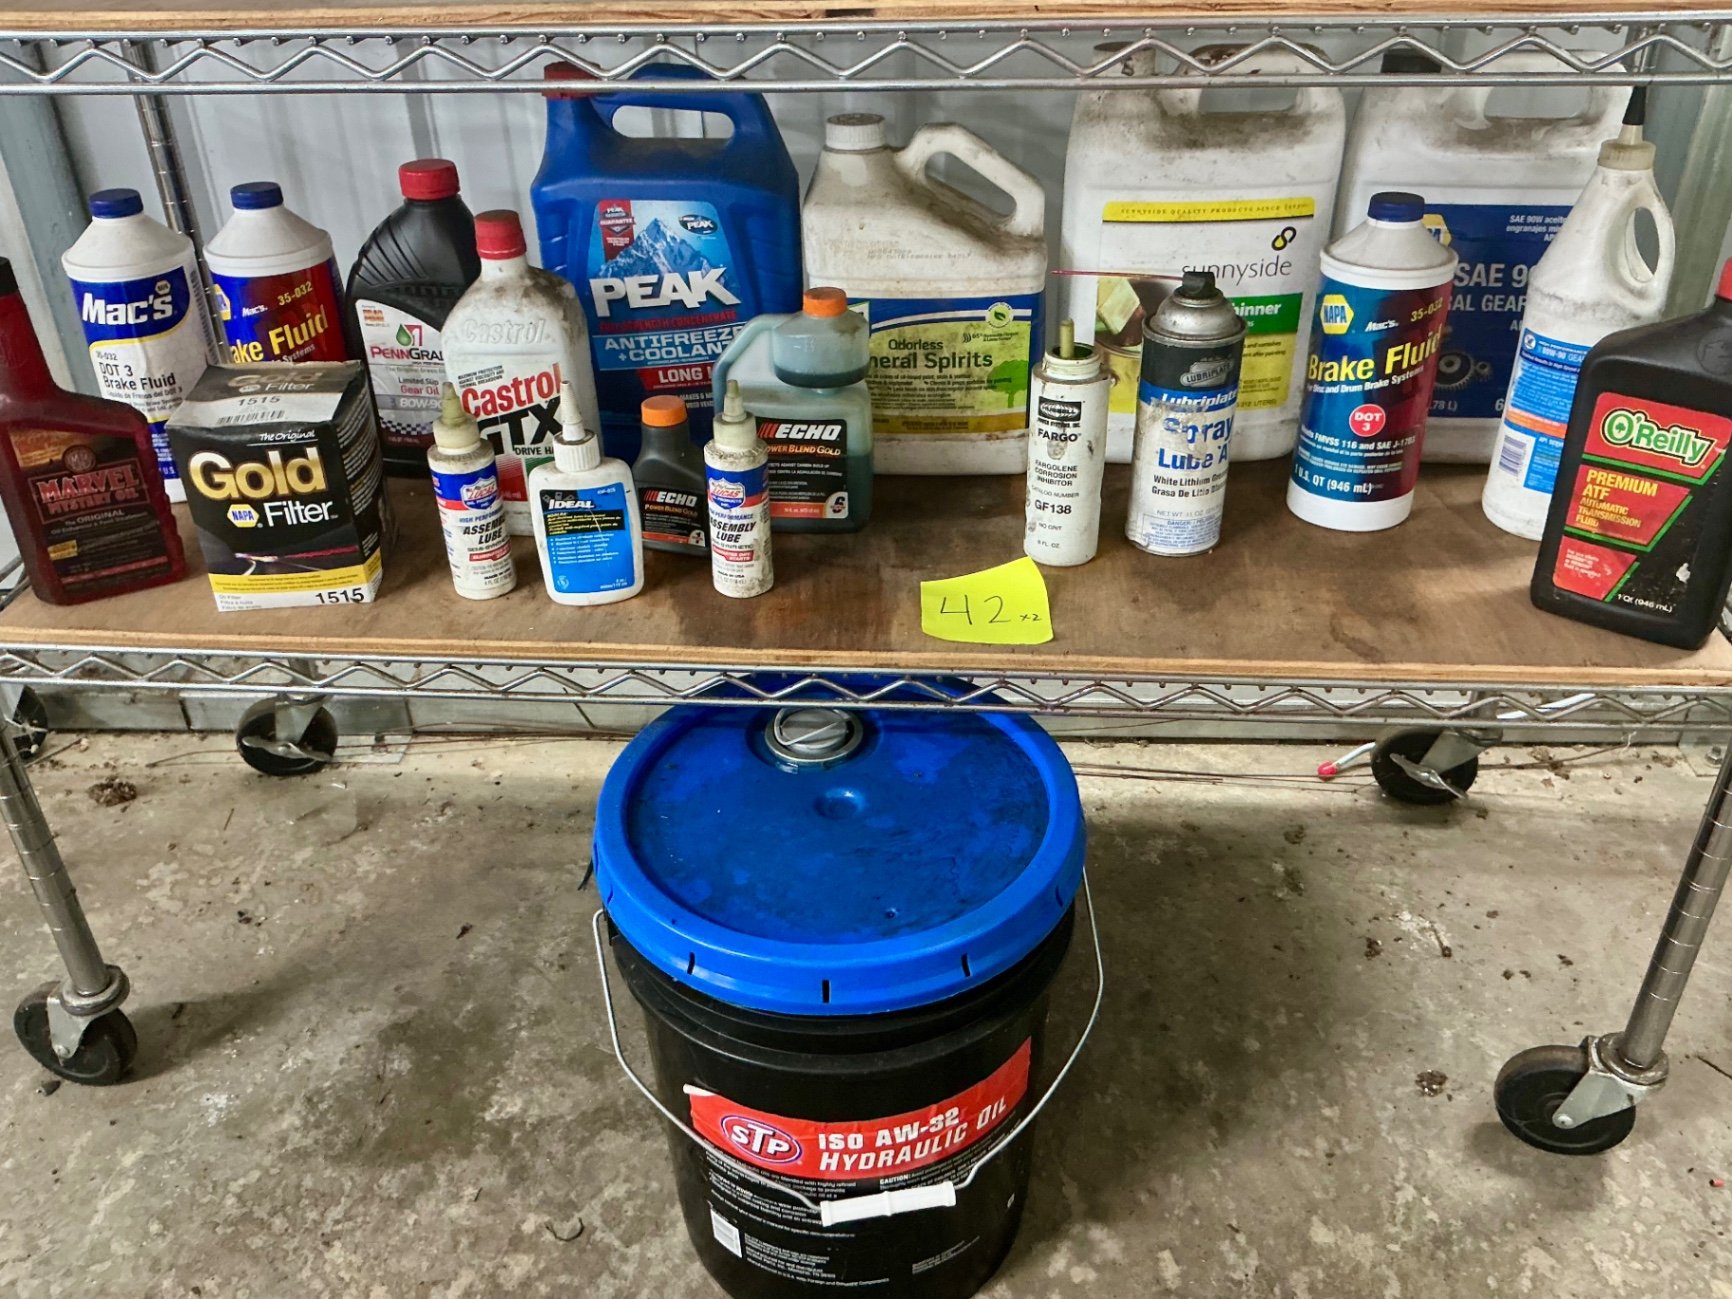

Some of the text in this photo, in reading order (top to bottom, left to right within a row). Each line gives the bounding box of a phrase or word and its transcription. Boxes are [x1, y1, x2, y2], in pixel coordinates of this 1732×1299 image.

[687, 220, 714, 230] PEAK
[1510, 215, 1525, 223] SAE
[1453, 262, 1505, 287] SAE
[276, 281, 314, 306] 35-032
[589, 267, 741, 318] PEAK
[82, 292, 173, 325] Mac's
[241, 304, 265, 318] Mac's
[1231, 302, 1282, 317] hinner
[1323, 304, 1348, 324] NAPA
[1364, 320, 1397, 333] Mac's
[1410, 297, 1443, 323] 35-032
[229, 338, 264, 364] ake
[268, 304, 328, 355] Fluid
[463, 318, 546, 346] Castrol
[888, 338, 943, 351] Odorless
[1308, 324, 1442, 382] Brake Fluid
[99, 362, 133, 377] DOT 3
[869, 351, 993, 375] neral Spirits
[102, 372, 177, 390] Brake Fluid
[227, 372, 324, 387] Gold
[398, 376, 439, 386] Limited Slip
[658, 367, 702, 384] LONG
[1187, 362, 1232, 383] LUBRIPLATE
[1325, 384, 1339, 393] and
[1340, 384, 1363, 393] Drum
[1364, 379, 1389, 391] Brake
[1391, 365, 1425, 384] Systems
[265, 382, 315, 391] Filter
[400, 384, 440, 395] Gear Oil
[462, 362, 562, 419] Castrol
[238, 395, 281, 406] 1515
[1355, 412, 1383, 422] DOT
[775, 423, 842, 441] ECHO
[1037, 427, 1078, 442] FARGO
[1163, 414, 1235, 445] Spray
[1362, 423, 1371, 431] 3
[275, 429, 315, 443] Original
[1315, 432, 1339, 447] FMVSS
[1341, 440, 1357, 449] 116
[1358, 441, 1374, 450] and
[1376, 440, 1391, 450] SAE
[1604, 410, 1708, 463] O'Reilly
[514, 446, 542, 456] DRIVE
[767, 444, 841, 455] OWER BLEND GOLD
[1035, 459, 1078, 472] FARGOLENE
[1158, 447, 1213, 470] Lube
[188, 446, 326, 500] Gold
[1035, 468, 1077, 479] CORROSION
[1036, 476, 1073, 487] INHIBITOR
[1153, 473, 1178, 486] White
[37, 464, 140, 503] MARVEL
[1152, 486, 1176, 497] Grasa
[1312, 474, 1325, 486] QT
[1327, 479, 1350, 493] (946
[1353, 483, 1372, 494] mL)
[1582, 483, 1610, 500] ATF
[1586, 469, 1658, 497] PREMIUM
[47, 487, 139, 515] MYSTERY OIL
[656, 490, 698, 507] ECHO
[713, 488, 740, 497] LUCAS
[1053, 491, 1079, 499] NUMBER
[549, 499, 594, 510] IDEAL
[1034, 500, 1072, 515] GF138
[1580, 497, 1629, 515] AUTOMATIC
[77, 509, 124, 523] ORIGINAL
[232, 509, 254, 522] NAPA
[263, 501, 332, 528] Filter
[1576, 515, 1599, 528] FLUID
[1578, 505, 1641, 528] TRANSMISSION
[463, 512, 506, 535] ASSEM
[479, 526, 503, 545] LUBE
[716, 533, 742, 543] LUBE
[316, 587, 365, 604] 1515
[1622, 595, 1633, 603] Qt
[1635, 595, 1654, 608] (946
[1655, 601, 1673, 613] mL)
[940, 594, 1011, 626] 42
[819, 1107, 960, 1150] ISO AW-32
[819, 1096, 1008, 1172] HYDRAULIC OIL
[730, 1123, 789, 1155] STP
[880, 1175, 909, 1184] CAUTION:
